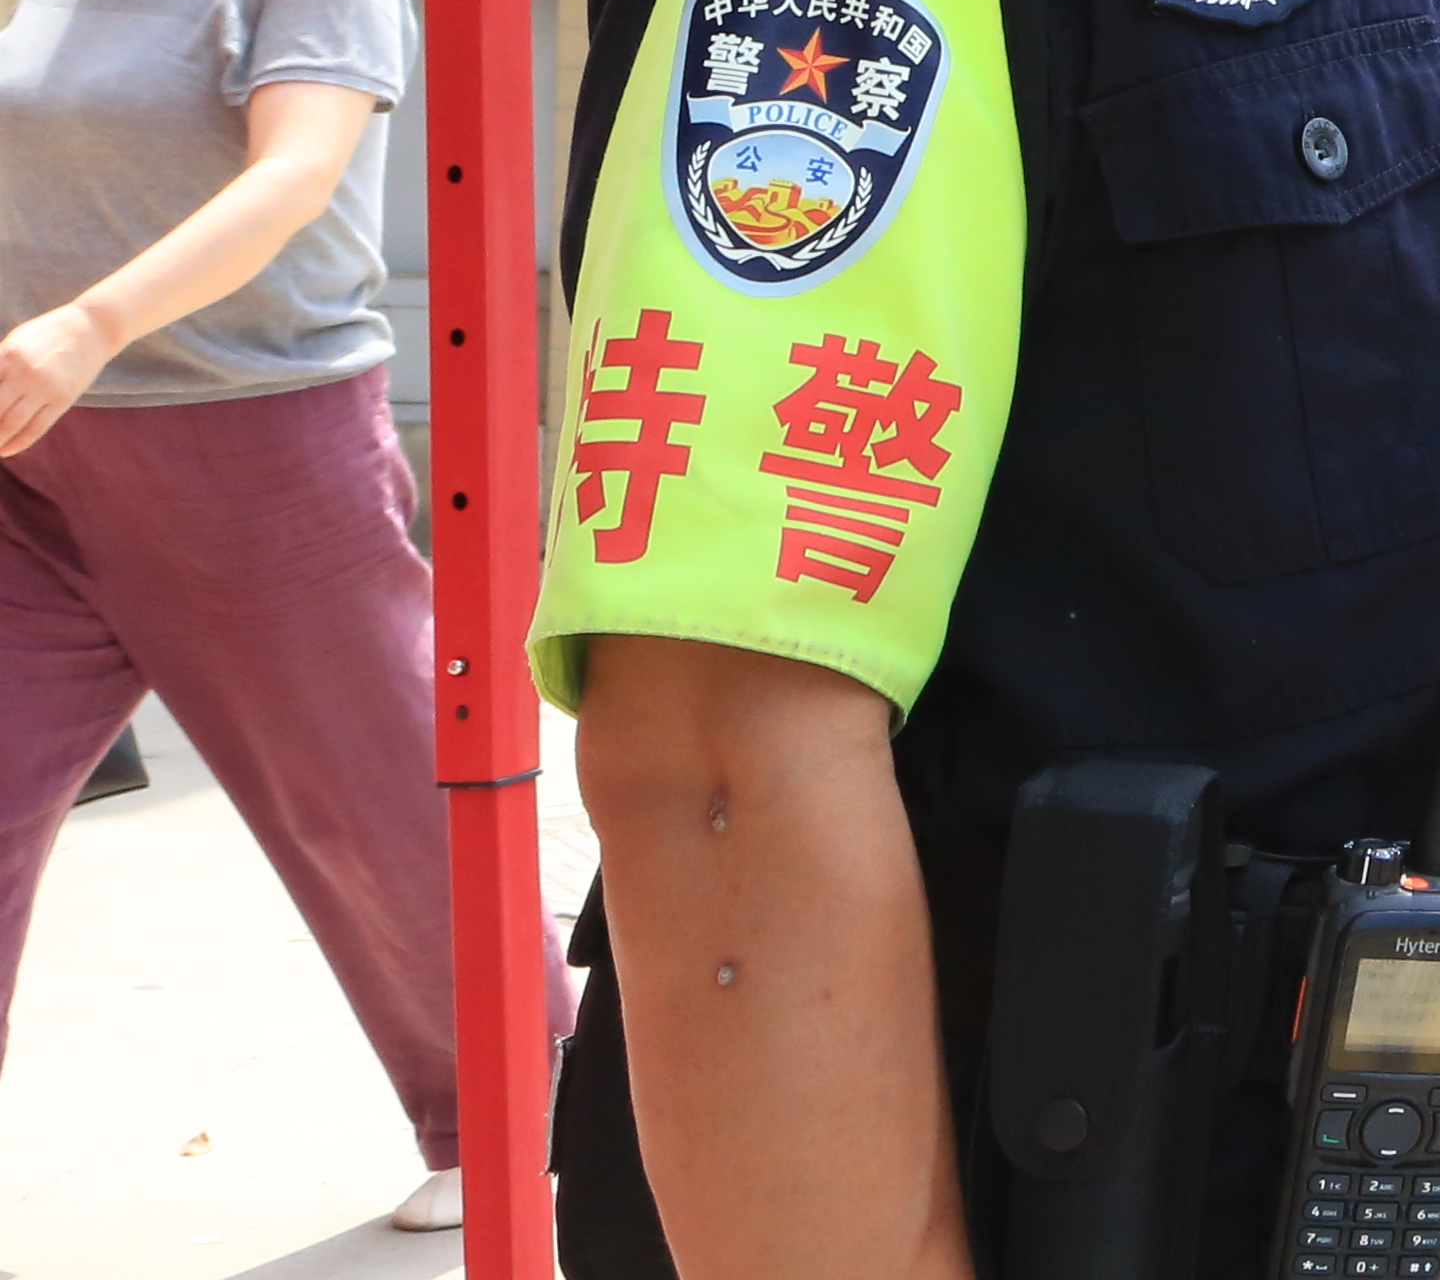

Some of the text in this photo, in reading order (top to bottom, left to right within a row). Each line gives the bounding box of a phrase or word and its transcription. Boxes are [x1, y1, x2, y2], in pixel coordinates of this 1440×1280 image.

[747, 104, 849, 141] POLICE
[735, 144, 836, 186] 公安
[548, 308, 962, 604] 特警
[1369, 1180, 1379, 1191] 2
[1421, 1182, 1431, 1193] 3
[1311, 1206, 1320, 1217] 4
[1363, 1208, 1373, 1218] 5
[1416, 1209, 1426, 1220] 6
[1307, 1232, 1316, 1243] 7
[1359, 1235, 1369, 1246] 8
[1412, 1235, 1422, 1247] 9
